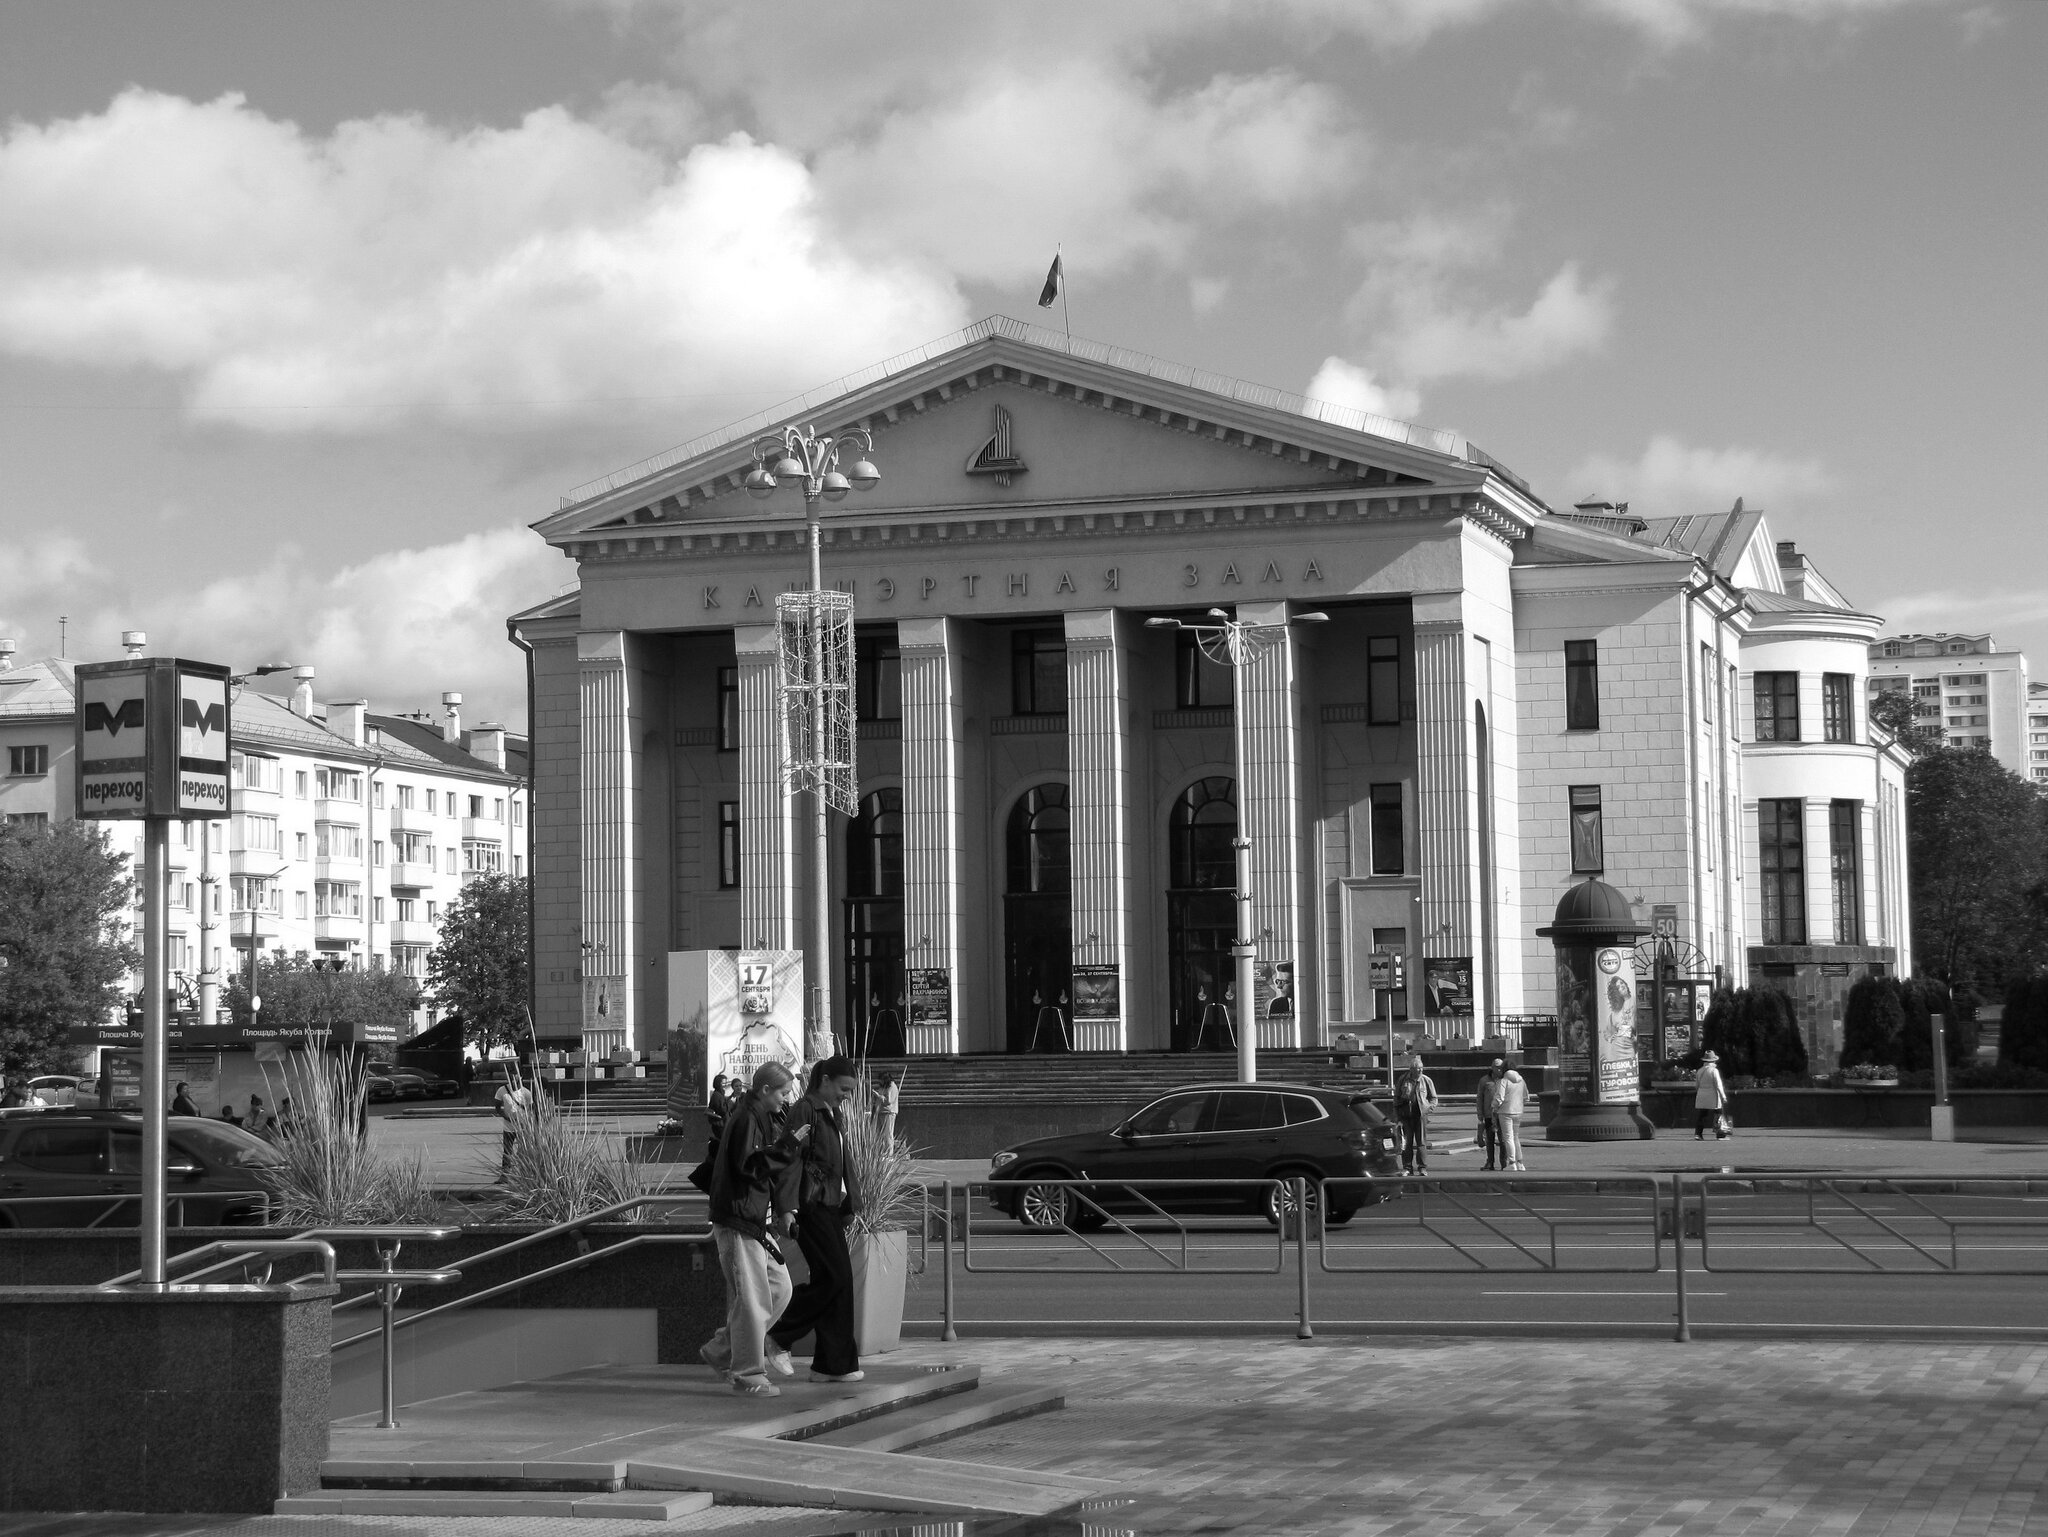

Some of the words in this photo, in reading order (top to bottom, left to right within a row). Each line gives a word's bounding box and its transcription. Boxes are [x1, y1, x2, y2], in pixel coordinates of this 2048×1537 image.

[1184, 558, 1324, 588] ЗАЛА
[85, 780, 143, 804] переход
[181, 779, 225, 805] переход
[1656, 918, 1675, 935] 50
[743, 965, 768, 985] 17
[741, 985, 771, 993] СЕНТЯБРЯ
[99, 1030, 129, 1038] Плошча
[130, 1030, 144, 1039] Яку
[242, 1028, 278, 1038] Площадь
[279, 1028, 303, 1037] Якуба
[304, 1028, 332, 1036] Коласа
[743, 1043, 769, 1054] ДЕНЬ
[728, 1054, 784, 1064] НАРОДНОГО
